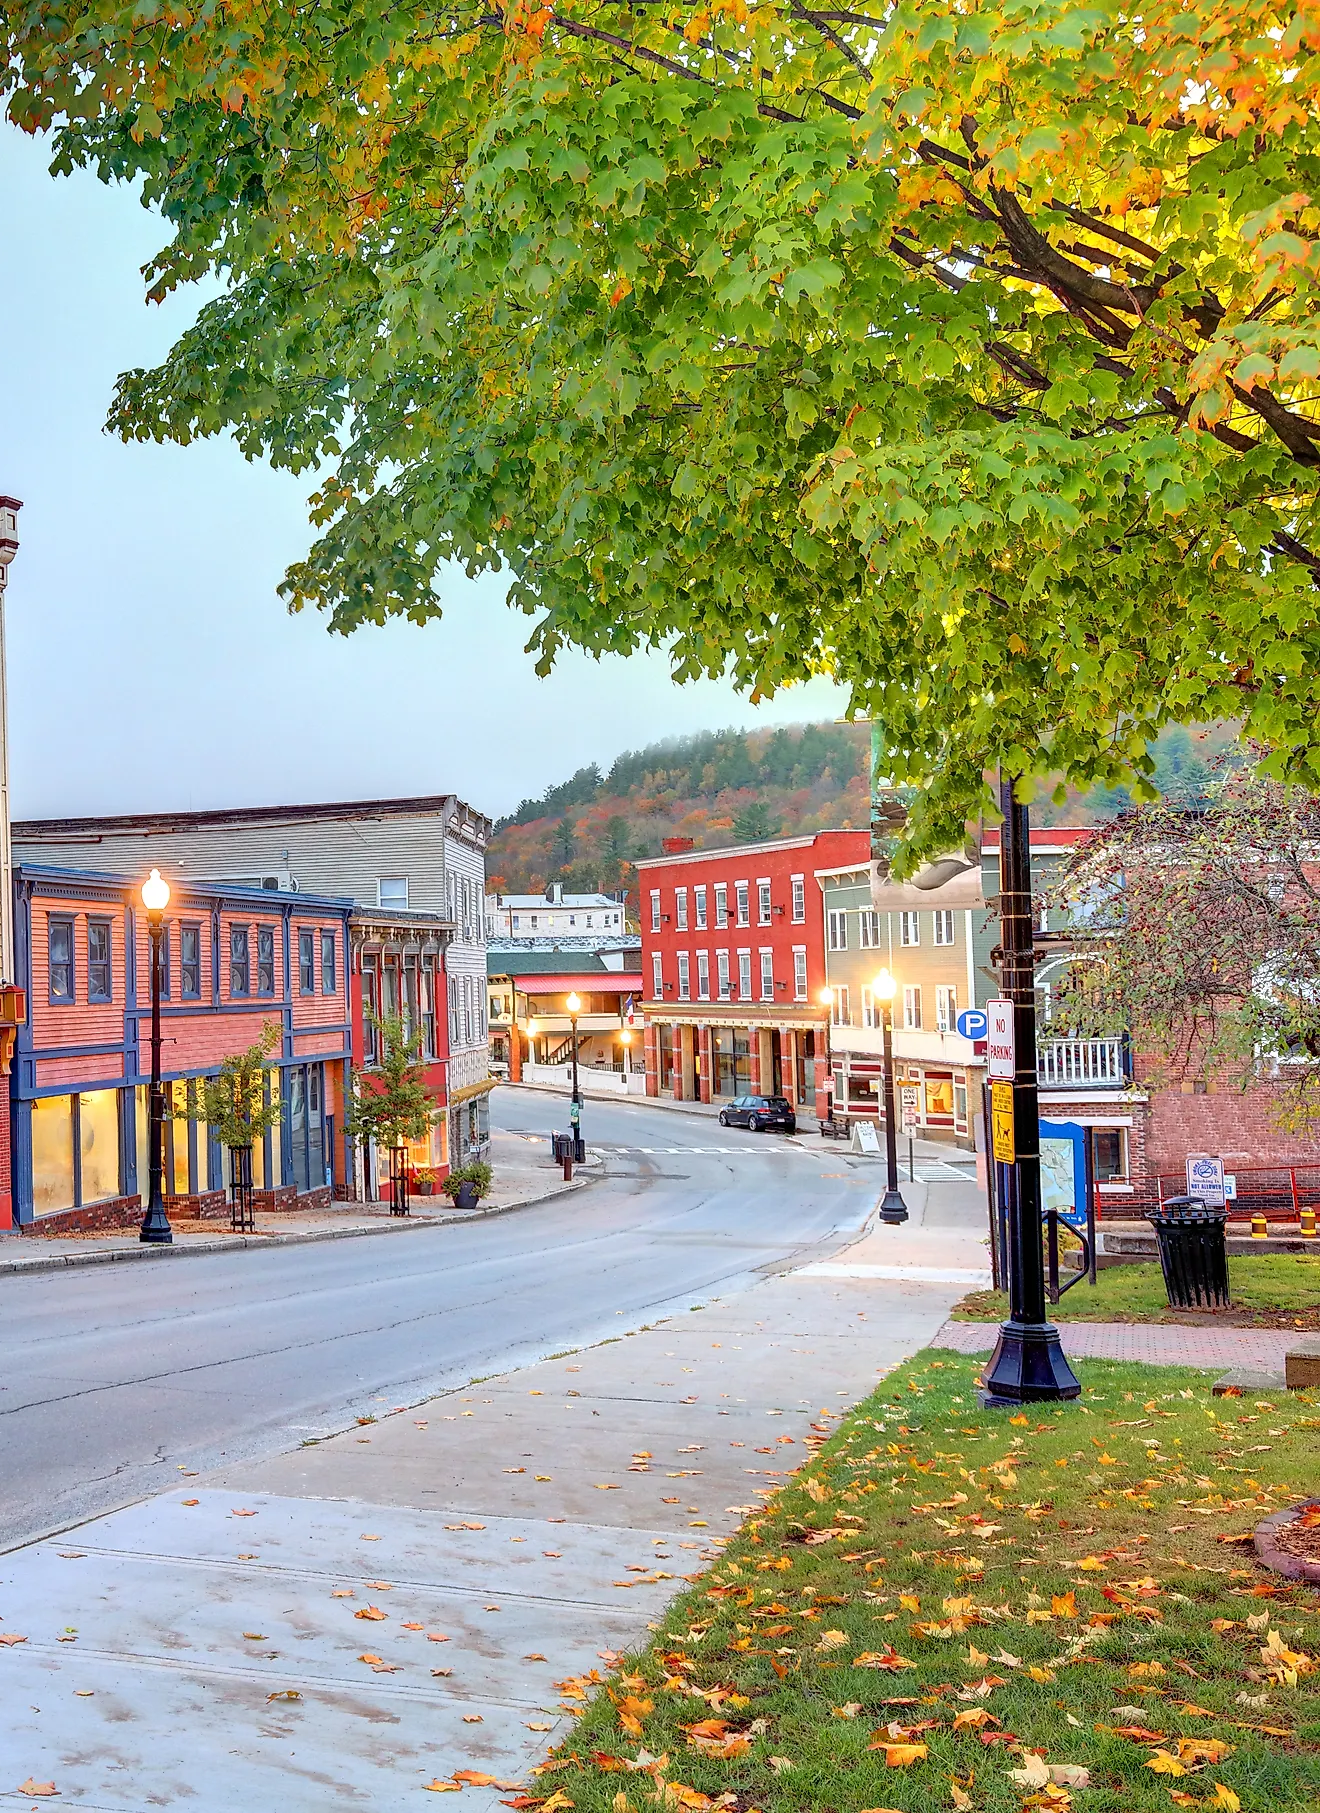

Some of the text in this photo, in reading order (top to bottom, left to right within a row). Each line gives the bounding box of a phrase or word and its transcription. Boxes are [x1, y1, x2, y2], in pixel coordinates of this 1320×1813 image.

[965, 1014, 985, 1036] P
[995, 1018, 1006, 1033] NO
[991, 1045, 1012, 1060] PARKING
